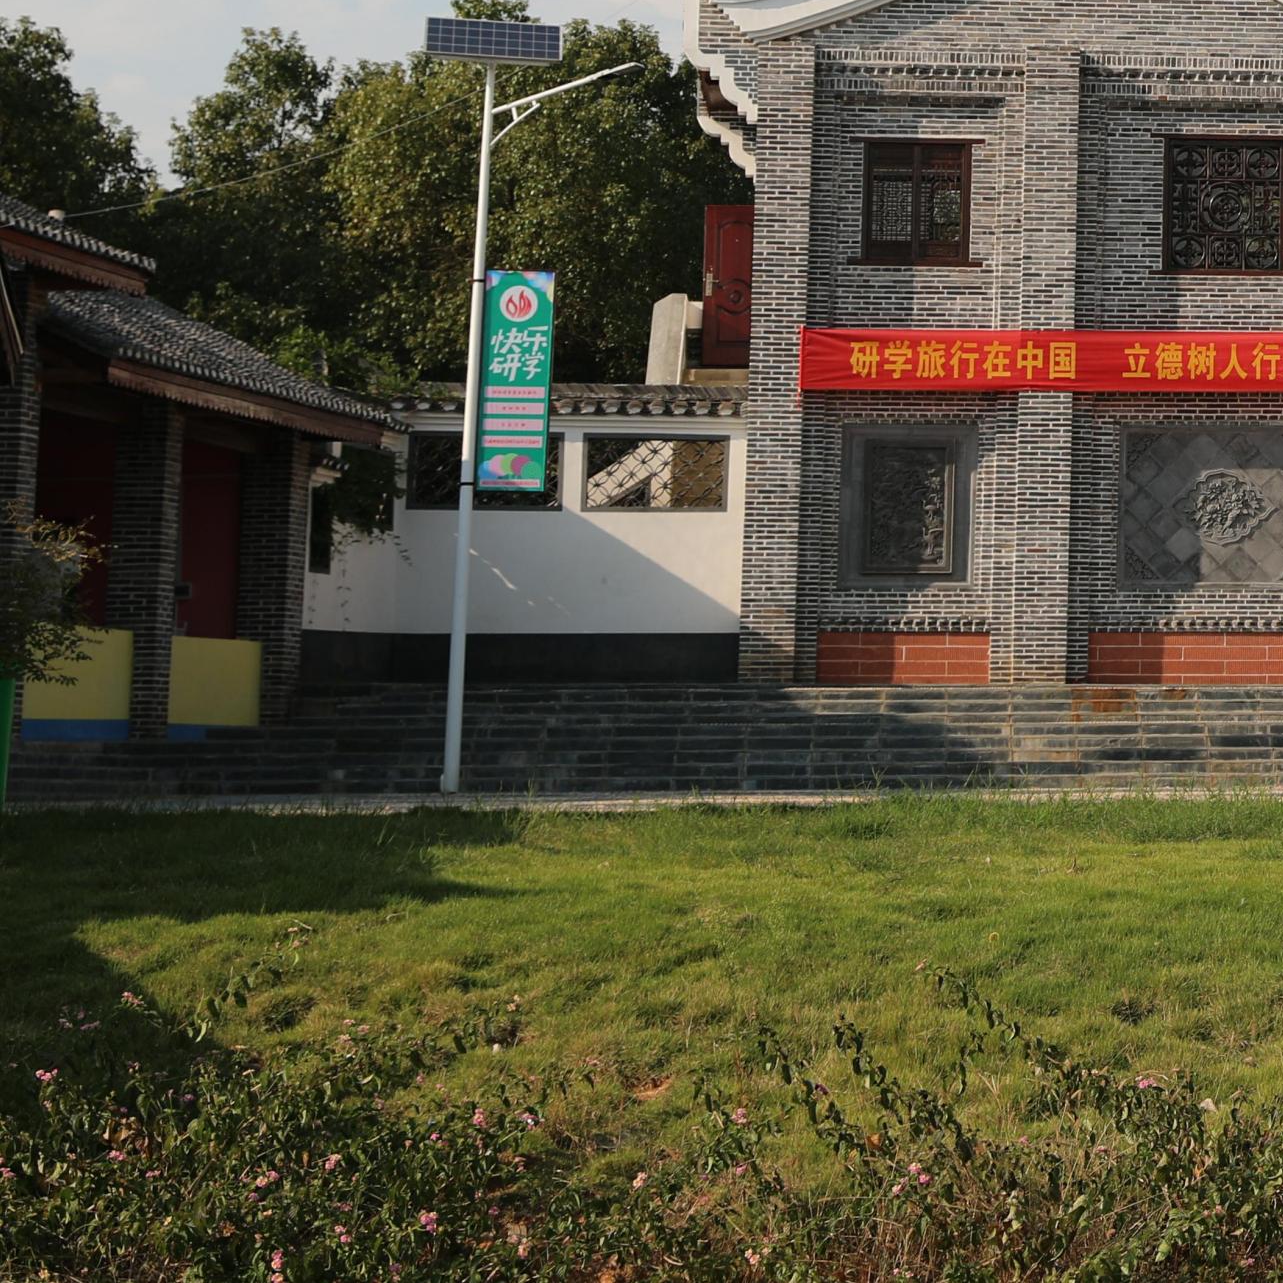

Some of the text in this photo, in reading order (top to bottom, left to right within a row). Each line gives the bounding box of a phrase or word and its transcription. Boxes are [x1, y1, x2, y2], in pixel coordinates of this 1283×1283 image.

[491, 325, 549, 354] 快乐
[488, 352, 545, 382] 研学
[849, 340, 1077, 380] 研学旅行在中国
